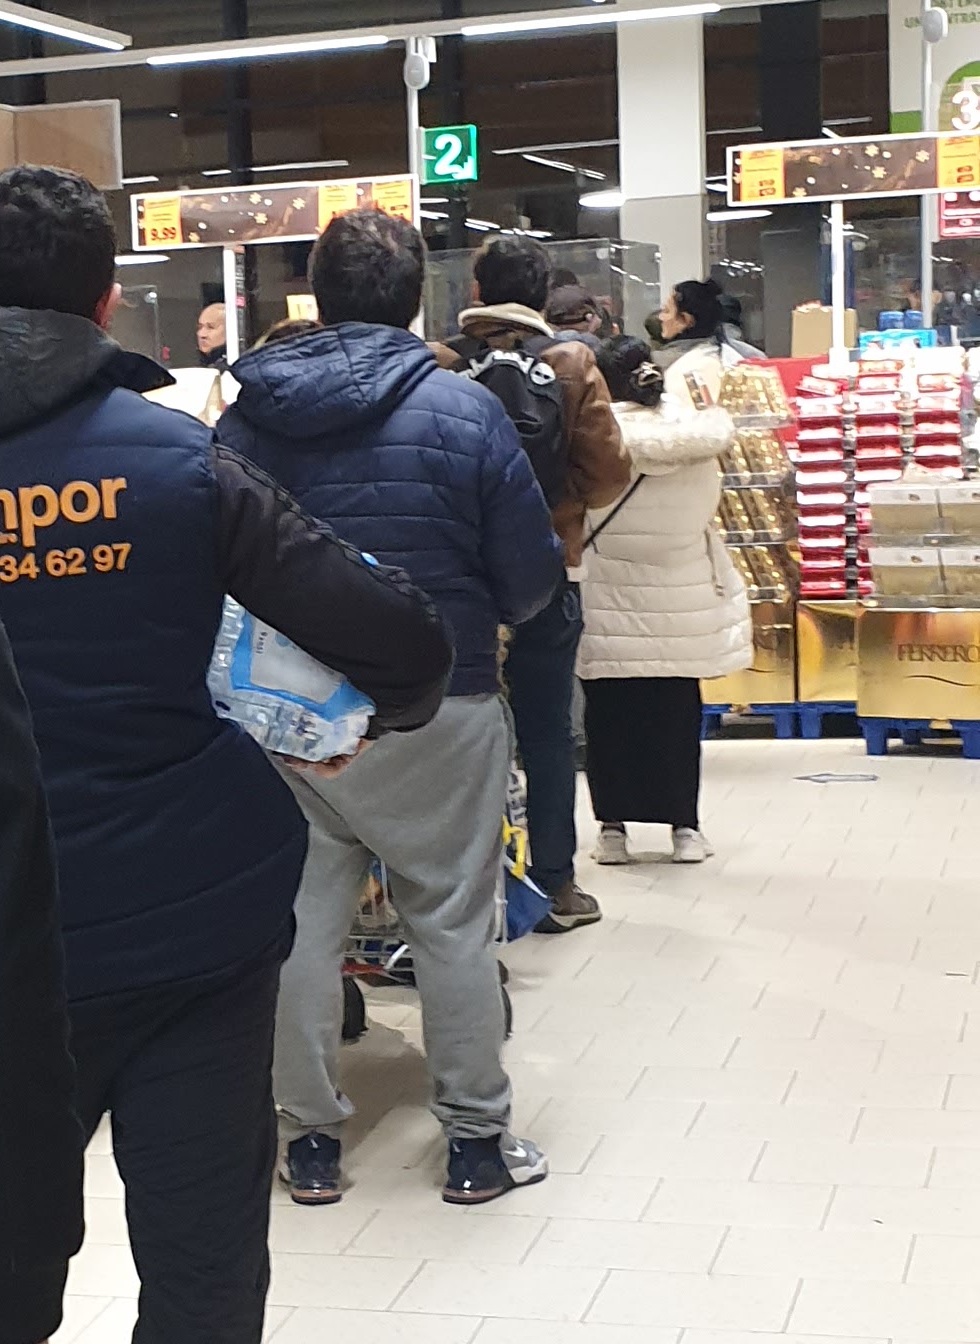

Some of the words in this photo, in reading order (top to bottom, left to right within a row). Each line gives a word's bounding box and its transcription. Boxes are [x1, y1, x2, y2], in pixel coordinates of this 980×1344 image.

[951, 90, 980, 130] 3
[434, 134, 465, 176] 2
[45, 547, 87, 577] 62
[92, 542, 132, 572] 97
[897, 643, 980, 662] FERRERO
